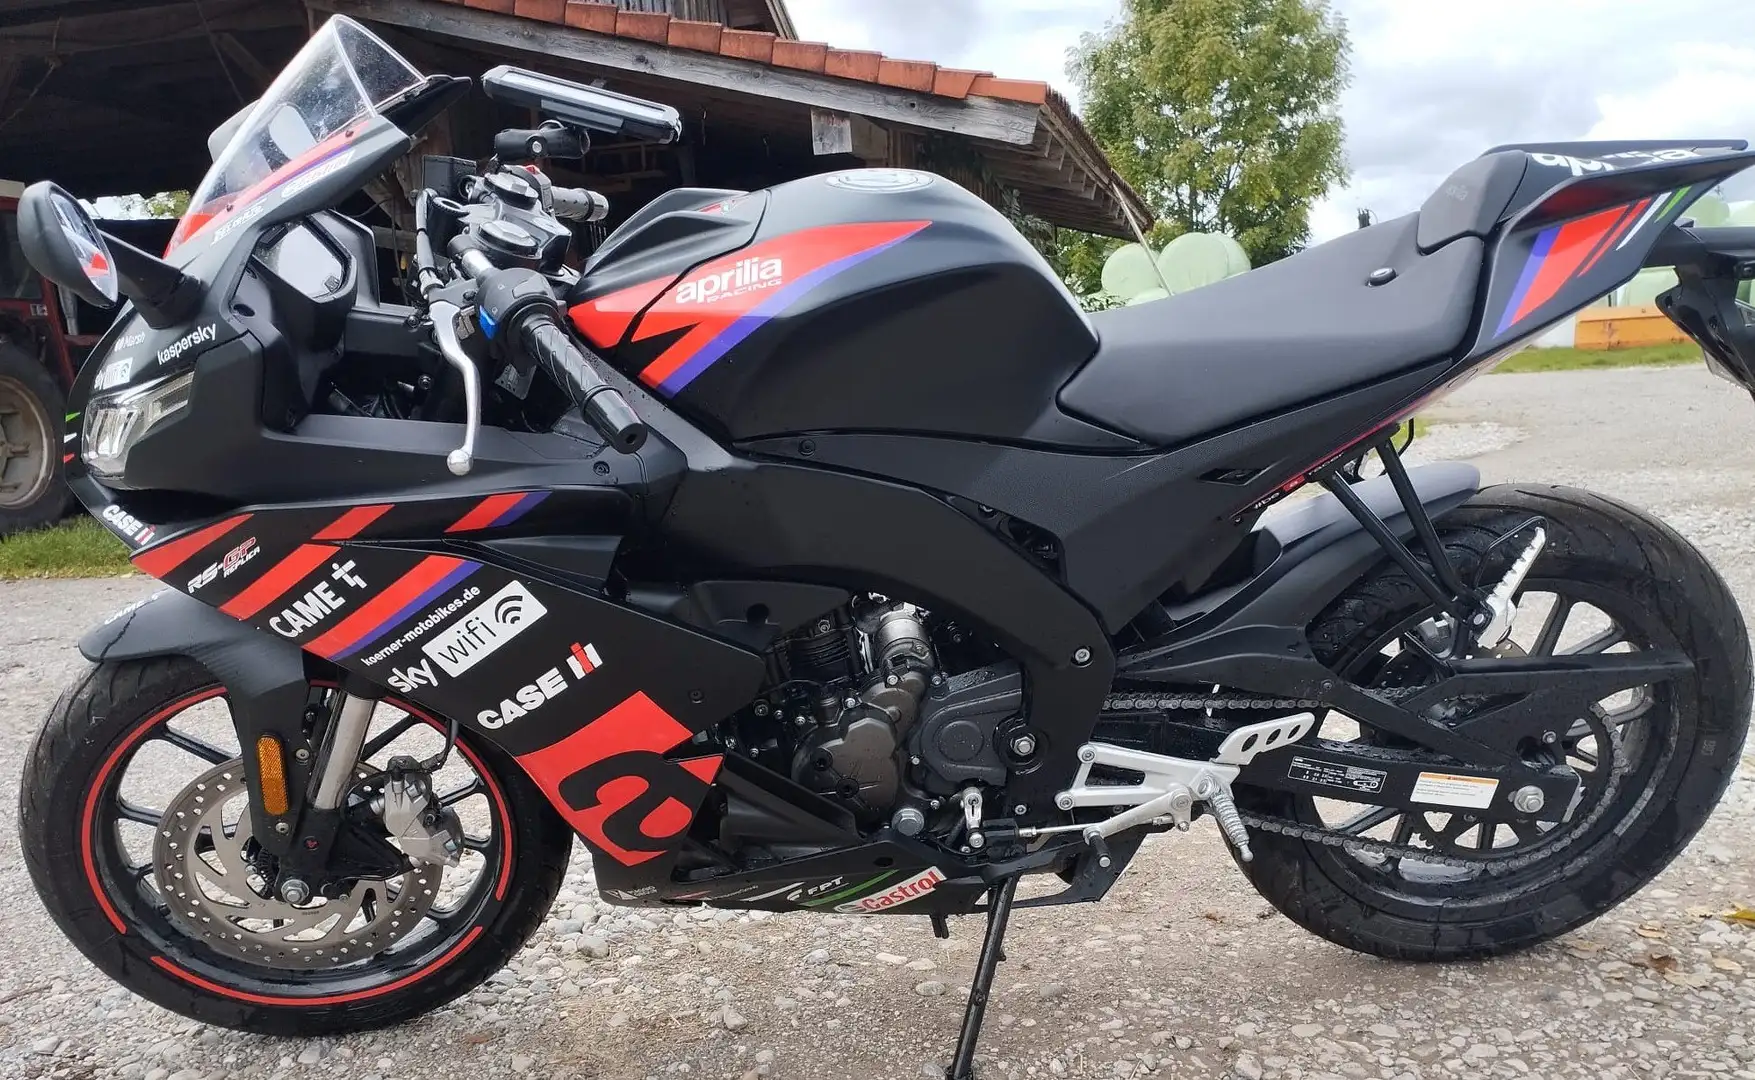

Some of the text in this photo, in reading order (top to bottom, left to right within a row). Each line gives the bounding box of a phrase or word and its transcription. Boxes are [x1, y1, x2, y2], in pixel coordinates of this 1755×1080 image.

[676, 257, 782, 303] aprilia
[706, 278, 782, 303] RACING
[157, 323, 217, 366] kaspersky
[102, 504, 144, 537] CASE
[223, 545, 261, 578] REPLICA
[269, 580, 346, 638] CAME
[360, 584, 481, 667] koerner-motobikes.de
[387, 615, 497, 693] sky wifi
[476, 666, 569, 730] CASE
[808, 876, 843, 896] FPT
[861, 870, 940, 910] Castrol
